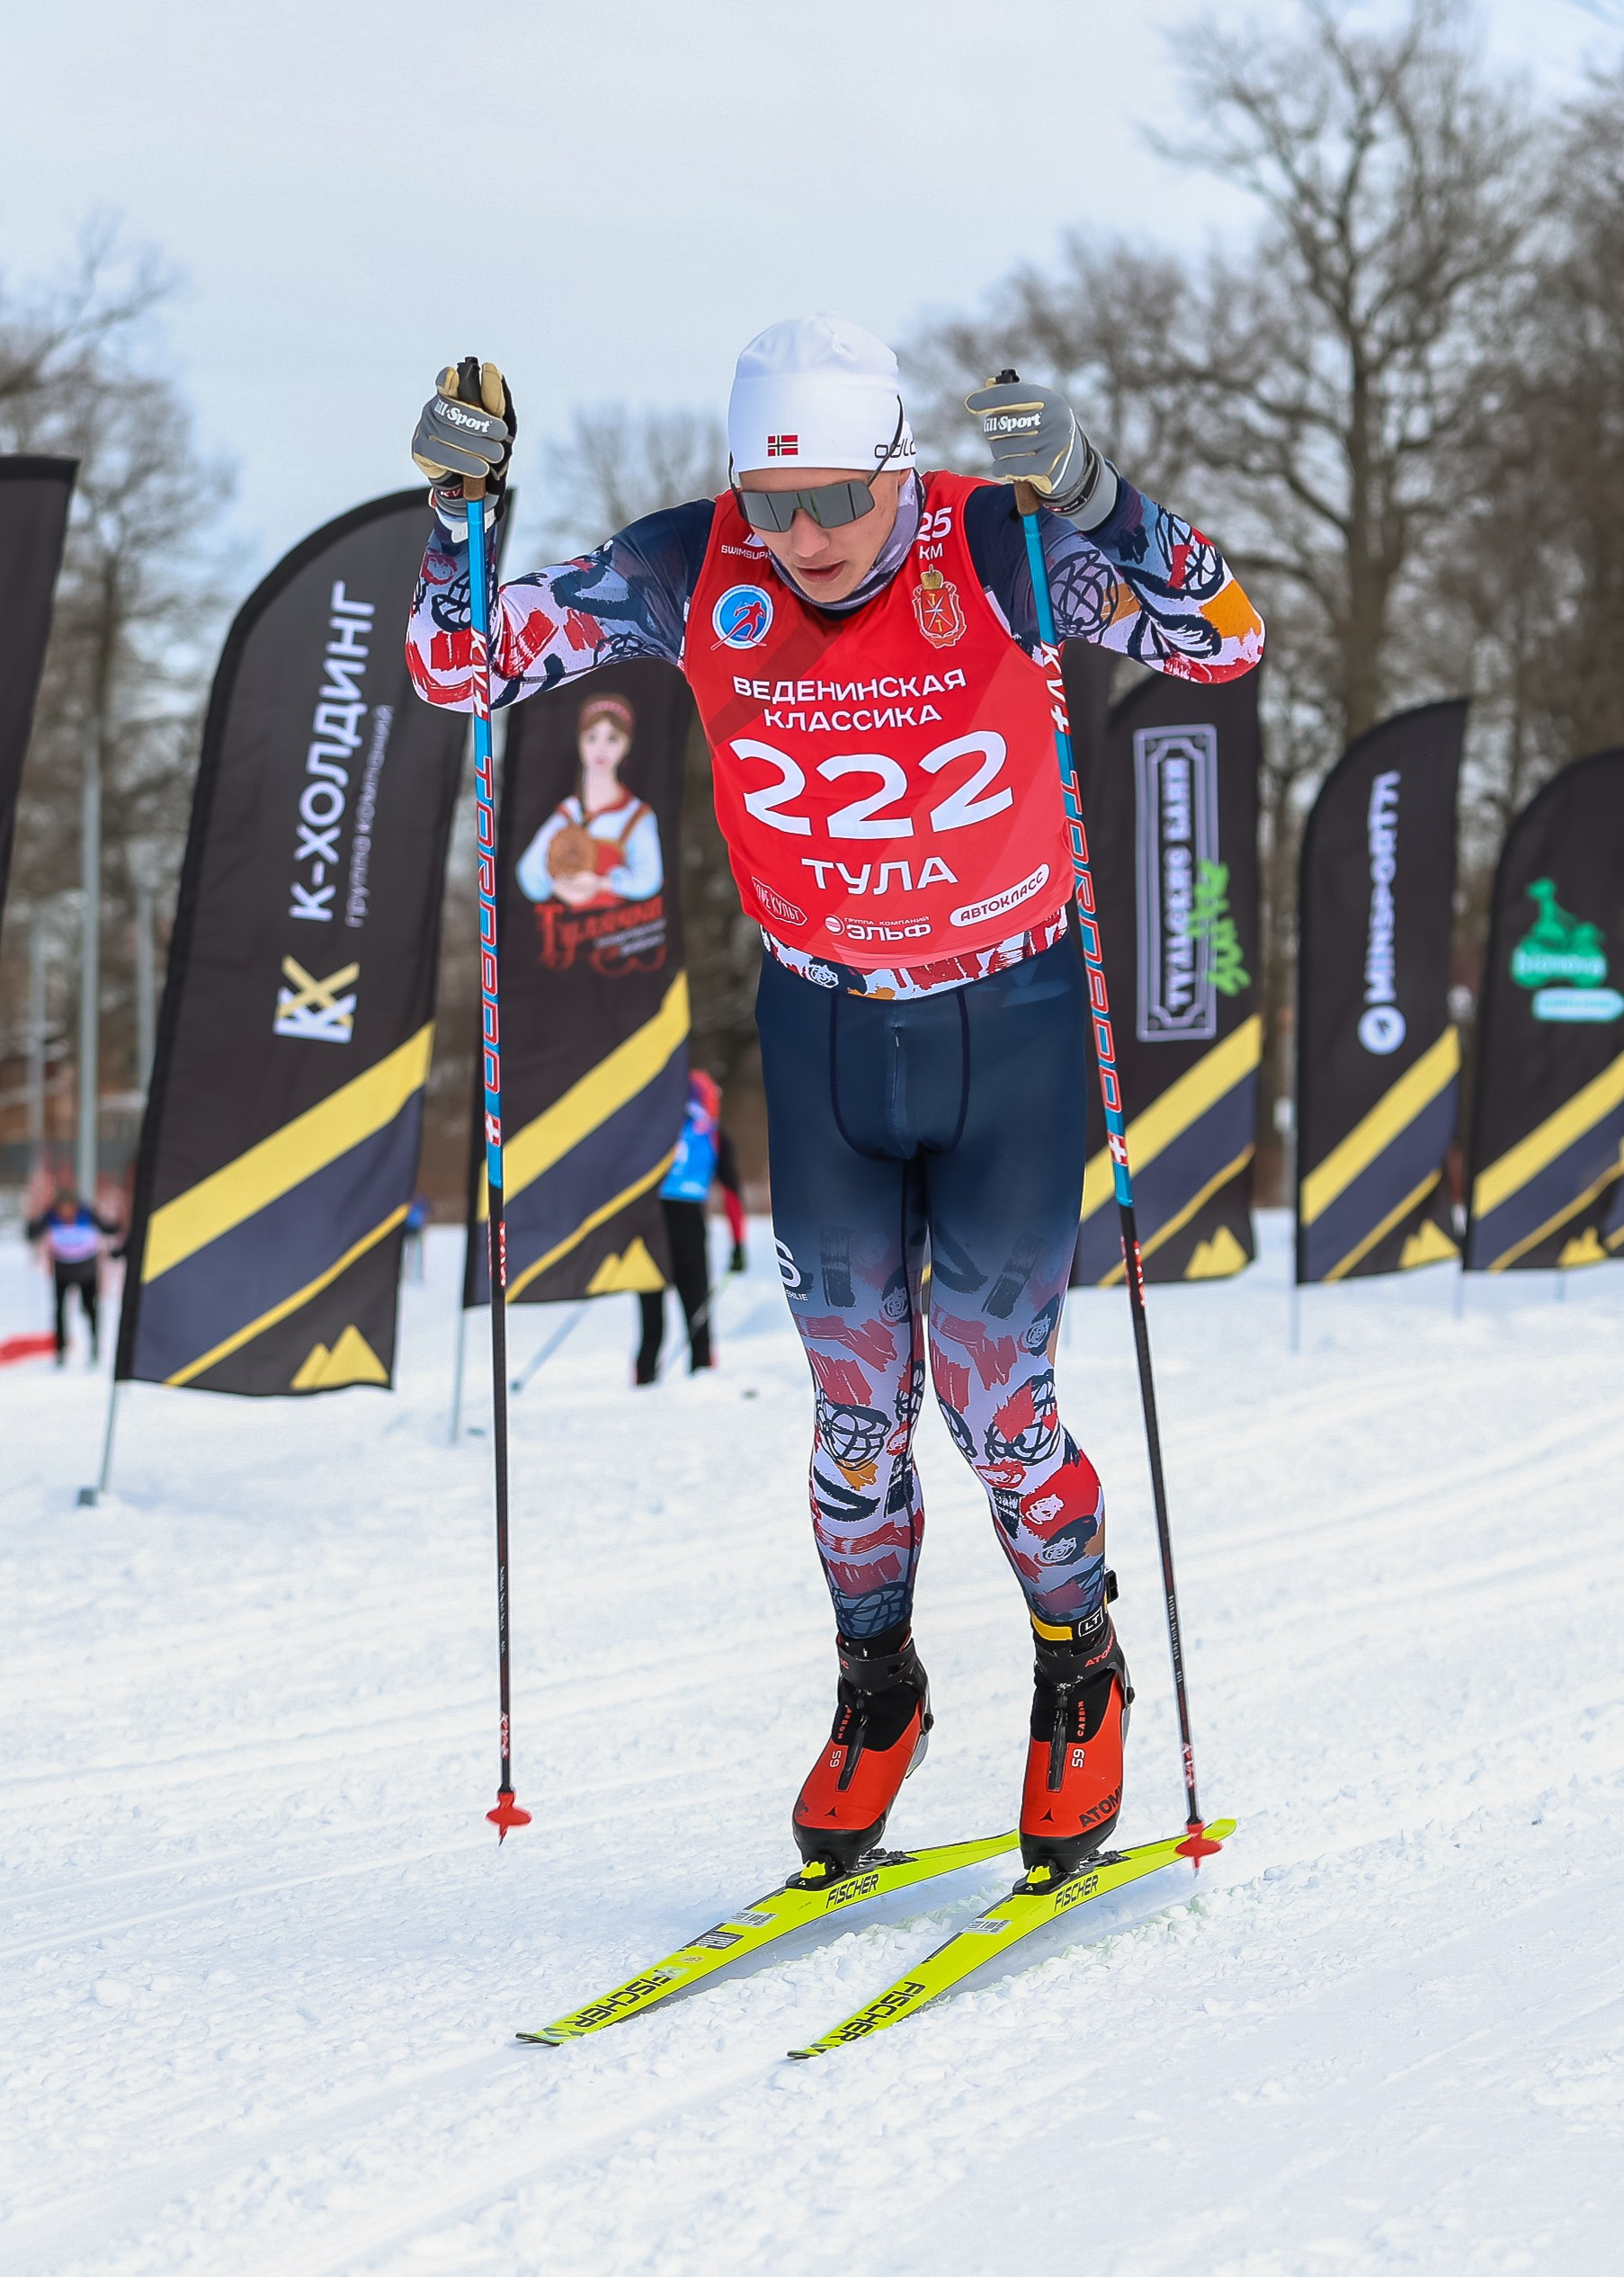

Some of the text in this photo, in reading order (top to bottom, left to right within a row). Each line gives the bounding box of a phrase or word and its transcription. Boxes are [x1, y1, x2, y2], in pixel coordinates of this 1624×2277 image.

[917, 506, 953, 541] 25
[733, 668, 967, 705] ВЕДЕНИНСКАЯ
[764, 704, 942, 732] КЛАССИКА
[288, 580, 376, 922] К-ХОЛДИНГ
[728, 730, 1014, 840] 222
[800, 856, 959, 895] ТУЛА
[960, 871, 1043, 921] АВТОКЛАСС
[846, 924, 932, 942] ЭЛЬФ
[879, 915, 930, 926] КОМПАНИЙ
[825, 1874, 879, 1909] FISCHER
[1054, 1875, 1099, 1912] FISCHER
[564, 1969, 673, 2028] FISCHER
[829, 1980, 927, 2043] FISCHER
